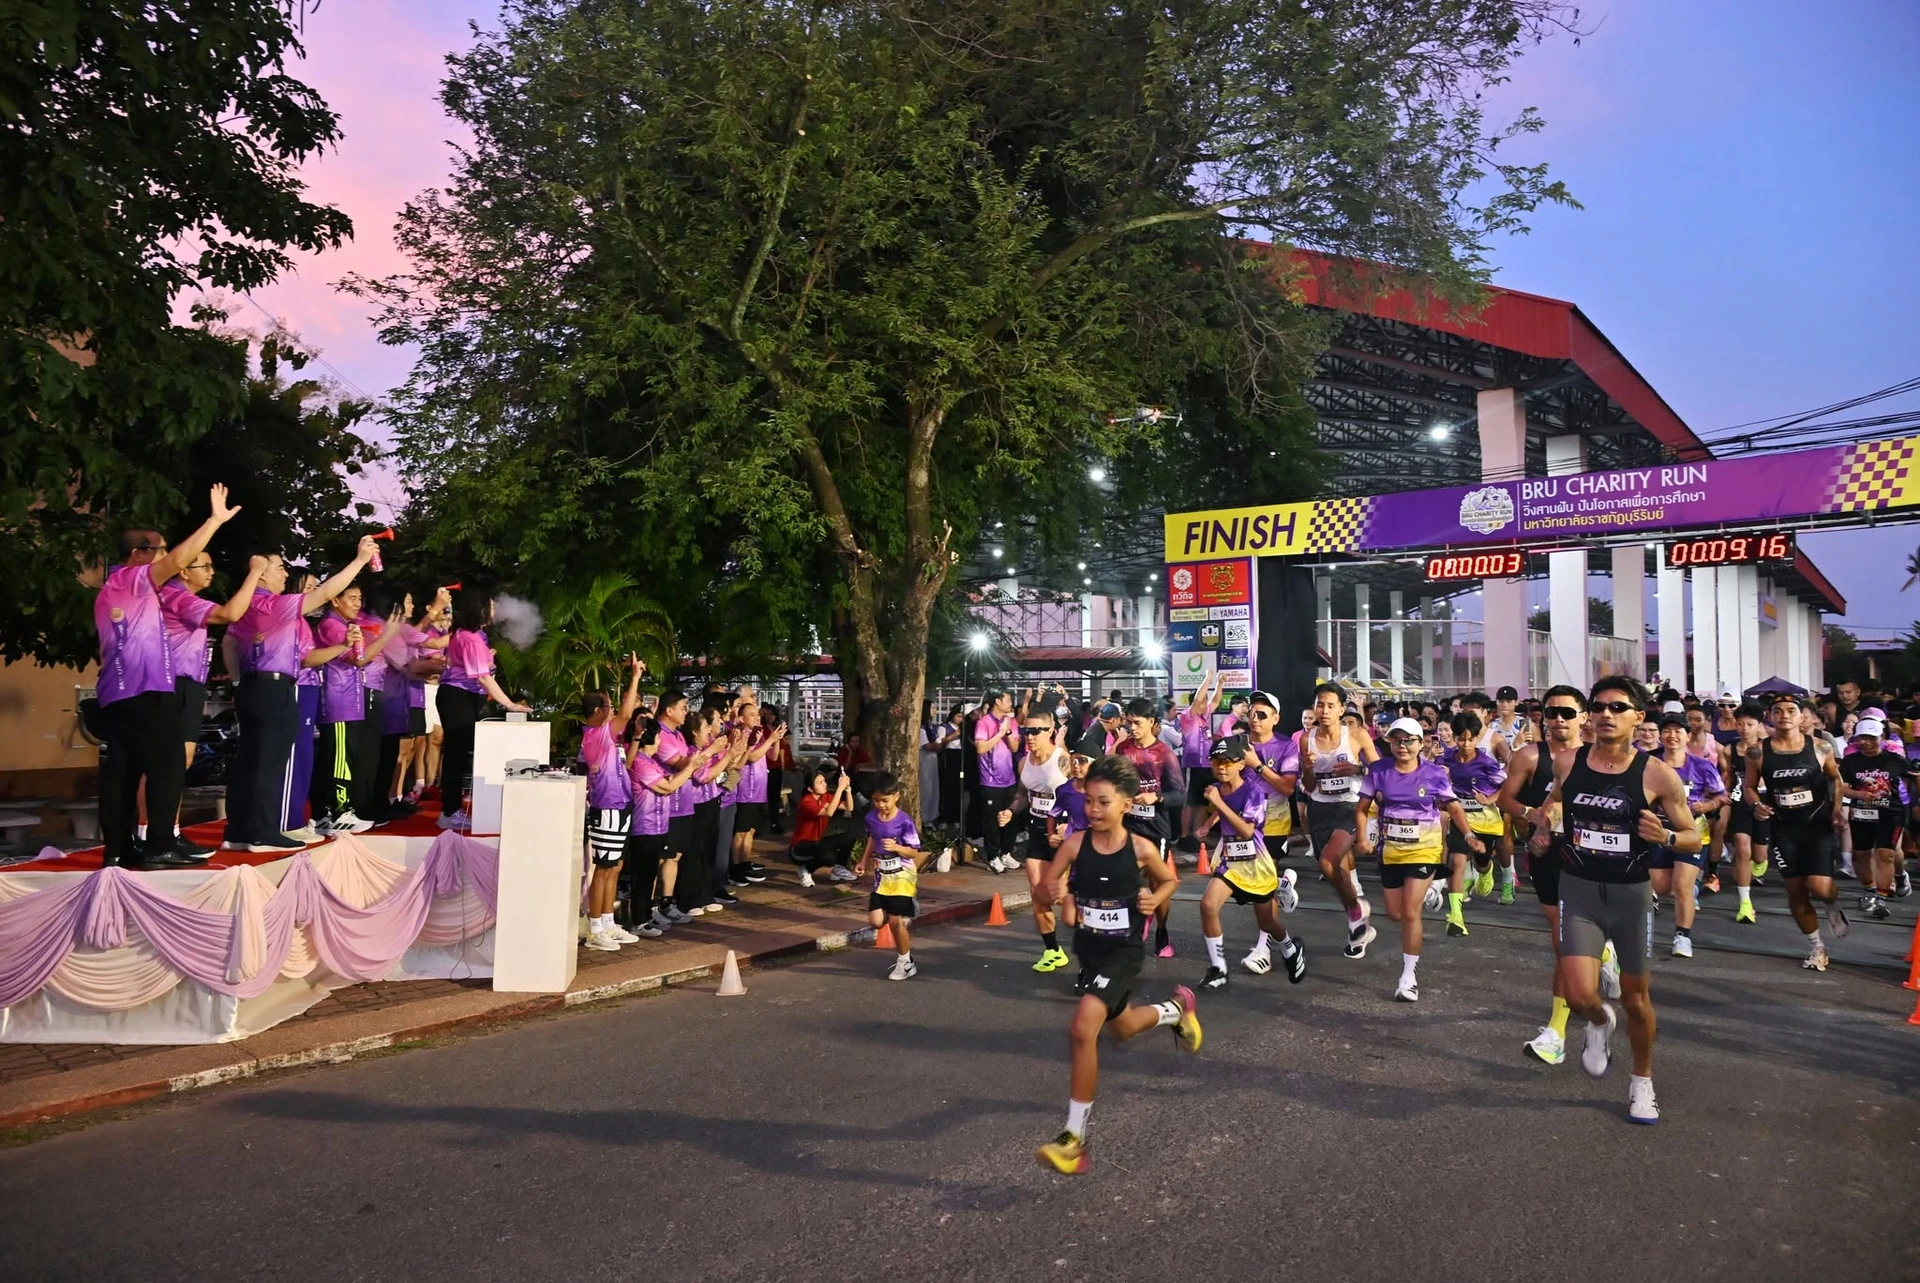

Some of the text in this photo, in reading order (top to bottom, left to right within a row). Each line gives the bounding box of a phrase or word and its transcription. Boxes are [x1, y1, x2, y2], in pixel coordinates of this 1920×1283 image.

[1522, 464, 1708, 500] BRU CHARITY RUN
[1523, 490, 1706, 517] วิ่งสานฝัน ปันโอกาสเพื่อการศึกษา
[1524, 506, 1665, 530] มหาวิทยาลัยราชภัฏบุรีรัมย์
[1184, 512, 1297, 555] FINISH
[1219, 608, 1248, 618] YAMAHA
[1773, 768, 1808, 779] GRR
[1330, 778, 1345, 787] 523
[1573, 792, 1624, 811] GRR
[1792, 793, 1806, 801] 213
[1398, 826, 1414, 834] 365
[1582, 832, 1619, 846] M 151
[1236, 843, 1248, 852] 514
[1099, 912, 1120, 923] 414
